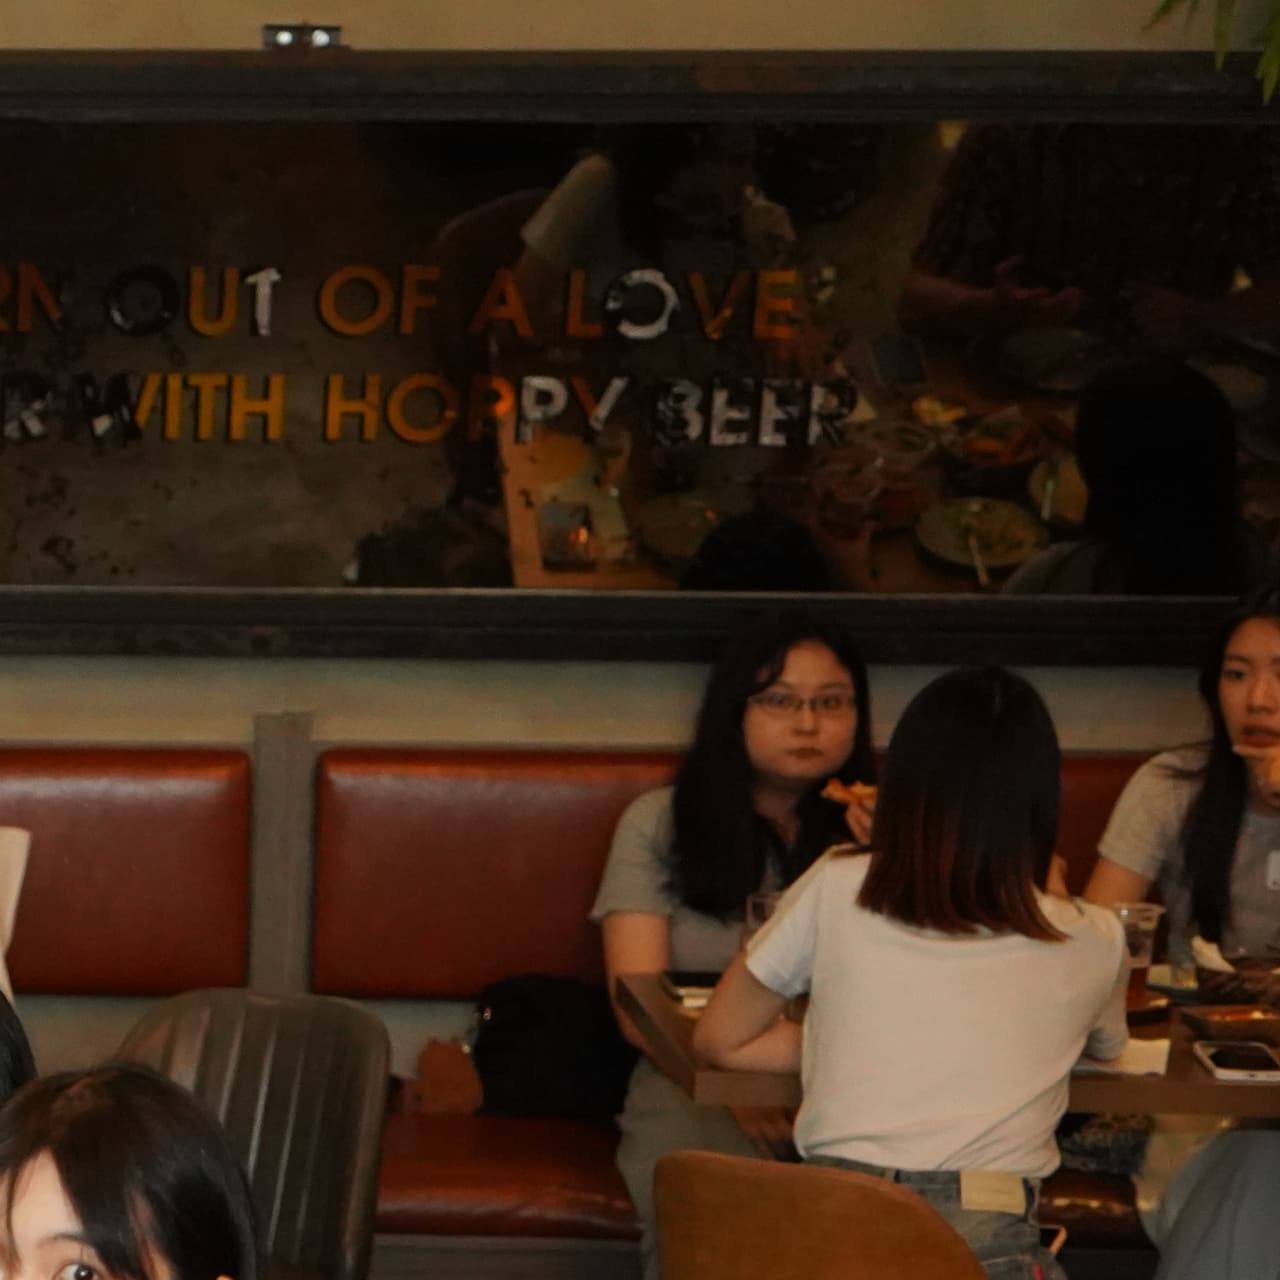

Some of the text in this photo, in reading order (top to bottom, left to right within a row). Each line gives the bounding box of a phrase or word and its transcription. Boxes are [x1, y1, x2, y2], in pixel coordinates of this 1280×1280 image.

[104, 263, 279, 337] OUT
[319, 264, 439, 337] OF
[469, 269, 535, 338] A
[565, 267, 801, 340] LOVE
[76, 372, 285, 442] WITH
[323, 372, 629, 446] HOPPY
[653, 375, 859, 447] BEER
